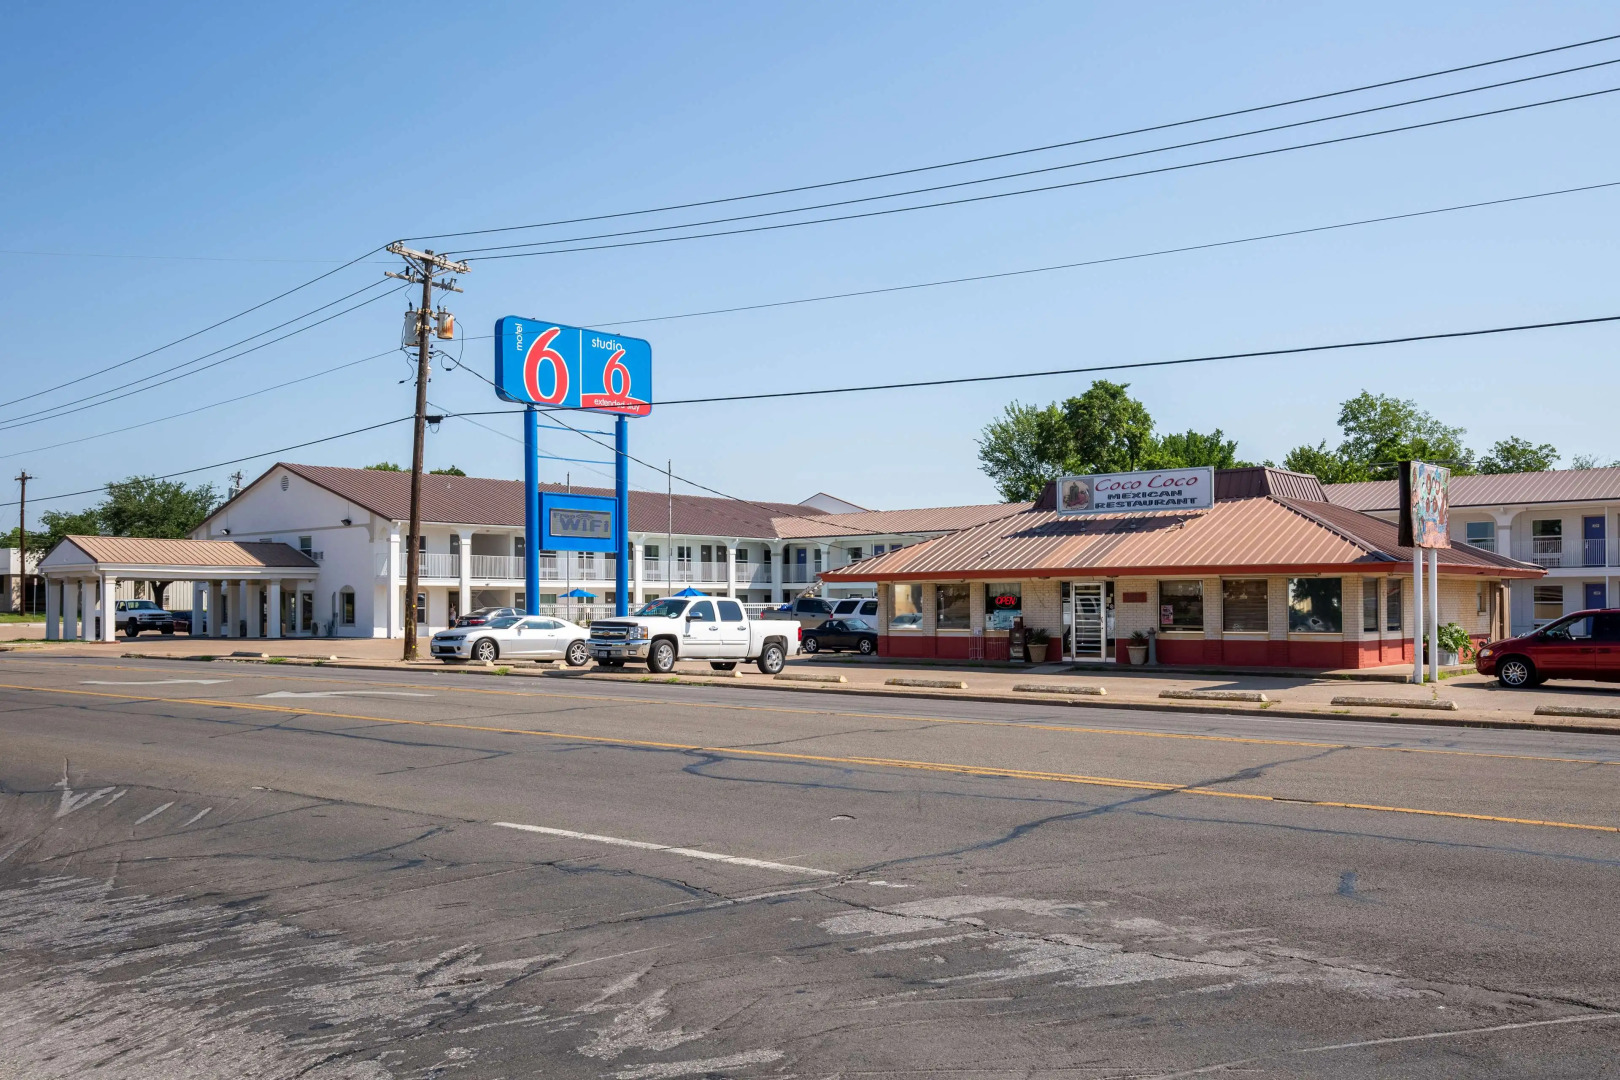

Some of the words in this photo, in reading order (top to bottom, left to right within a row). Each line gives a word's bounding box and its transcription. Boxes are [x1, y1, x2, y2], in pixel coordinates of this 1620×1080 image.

[591, 337, 623, 351] studio
[515, 323, 523, 351] motel
[523, 327, 569, 404] 6
[603, 349, 631, 398] 6
[594, 398, 626, 409] extended
[1095, 478, 1141, 492] Coco
[1147, 474, 1198, 488] Loco
[1107, 490, 1182, 500] MEXICAN
[1095, 498, 1197, 509] RESTAURANT
[995, 596, 1016, 605] OPEN
